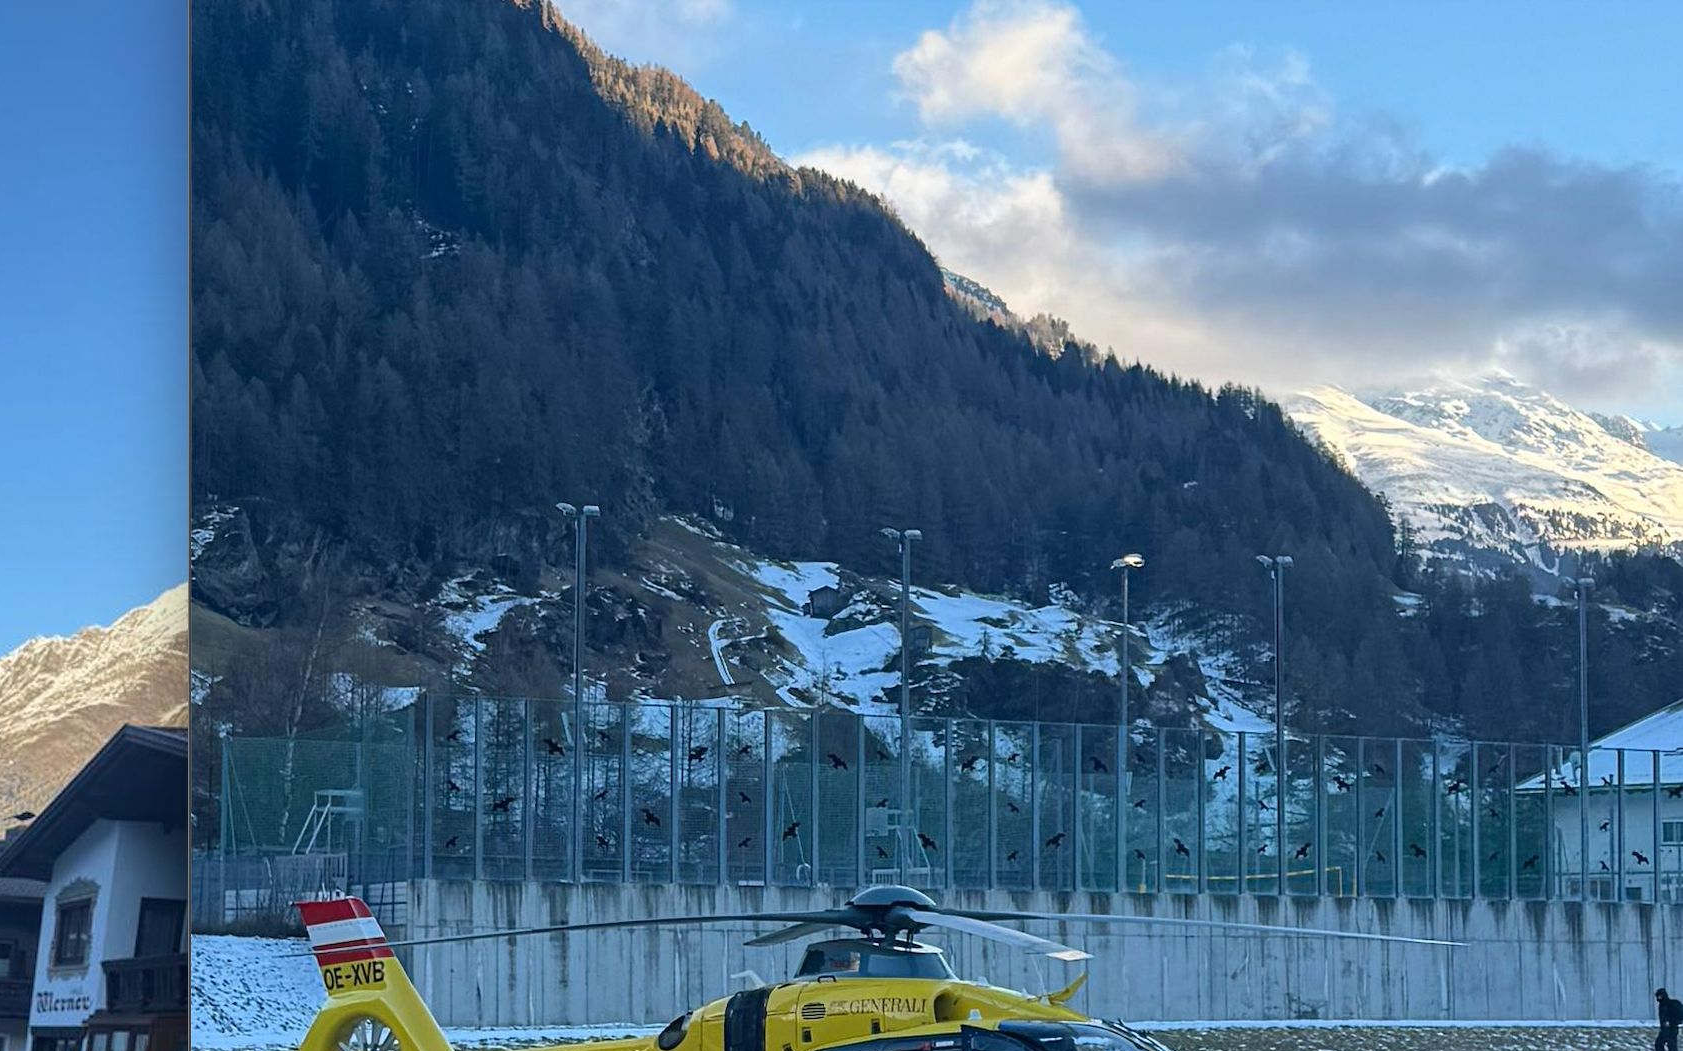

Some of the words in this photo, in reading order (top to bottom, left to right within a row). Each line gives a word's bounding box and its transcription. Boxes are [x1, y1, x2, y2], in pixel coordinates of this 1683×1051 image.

[324, 961, 385, 990] OE-XVB
[37, 991, 92, 1014] Werner
[850, 998, 927, 1014] GENERALI
